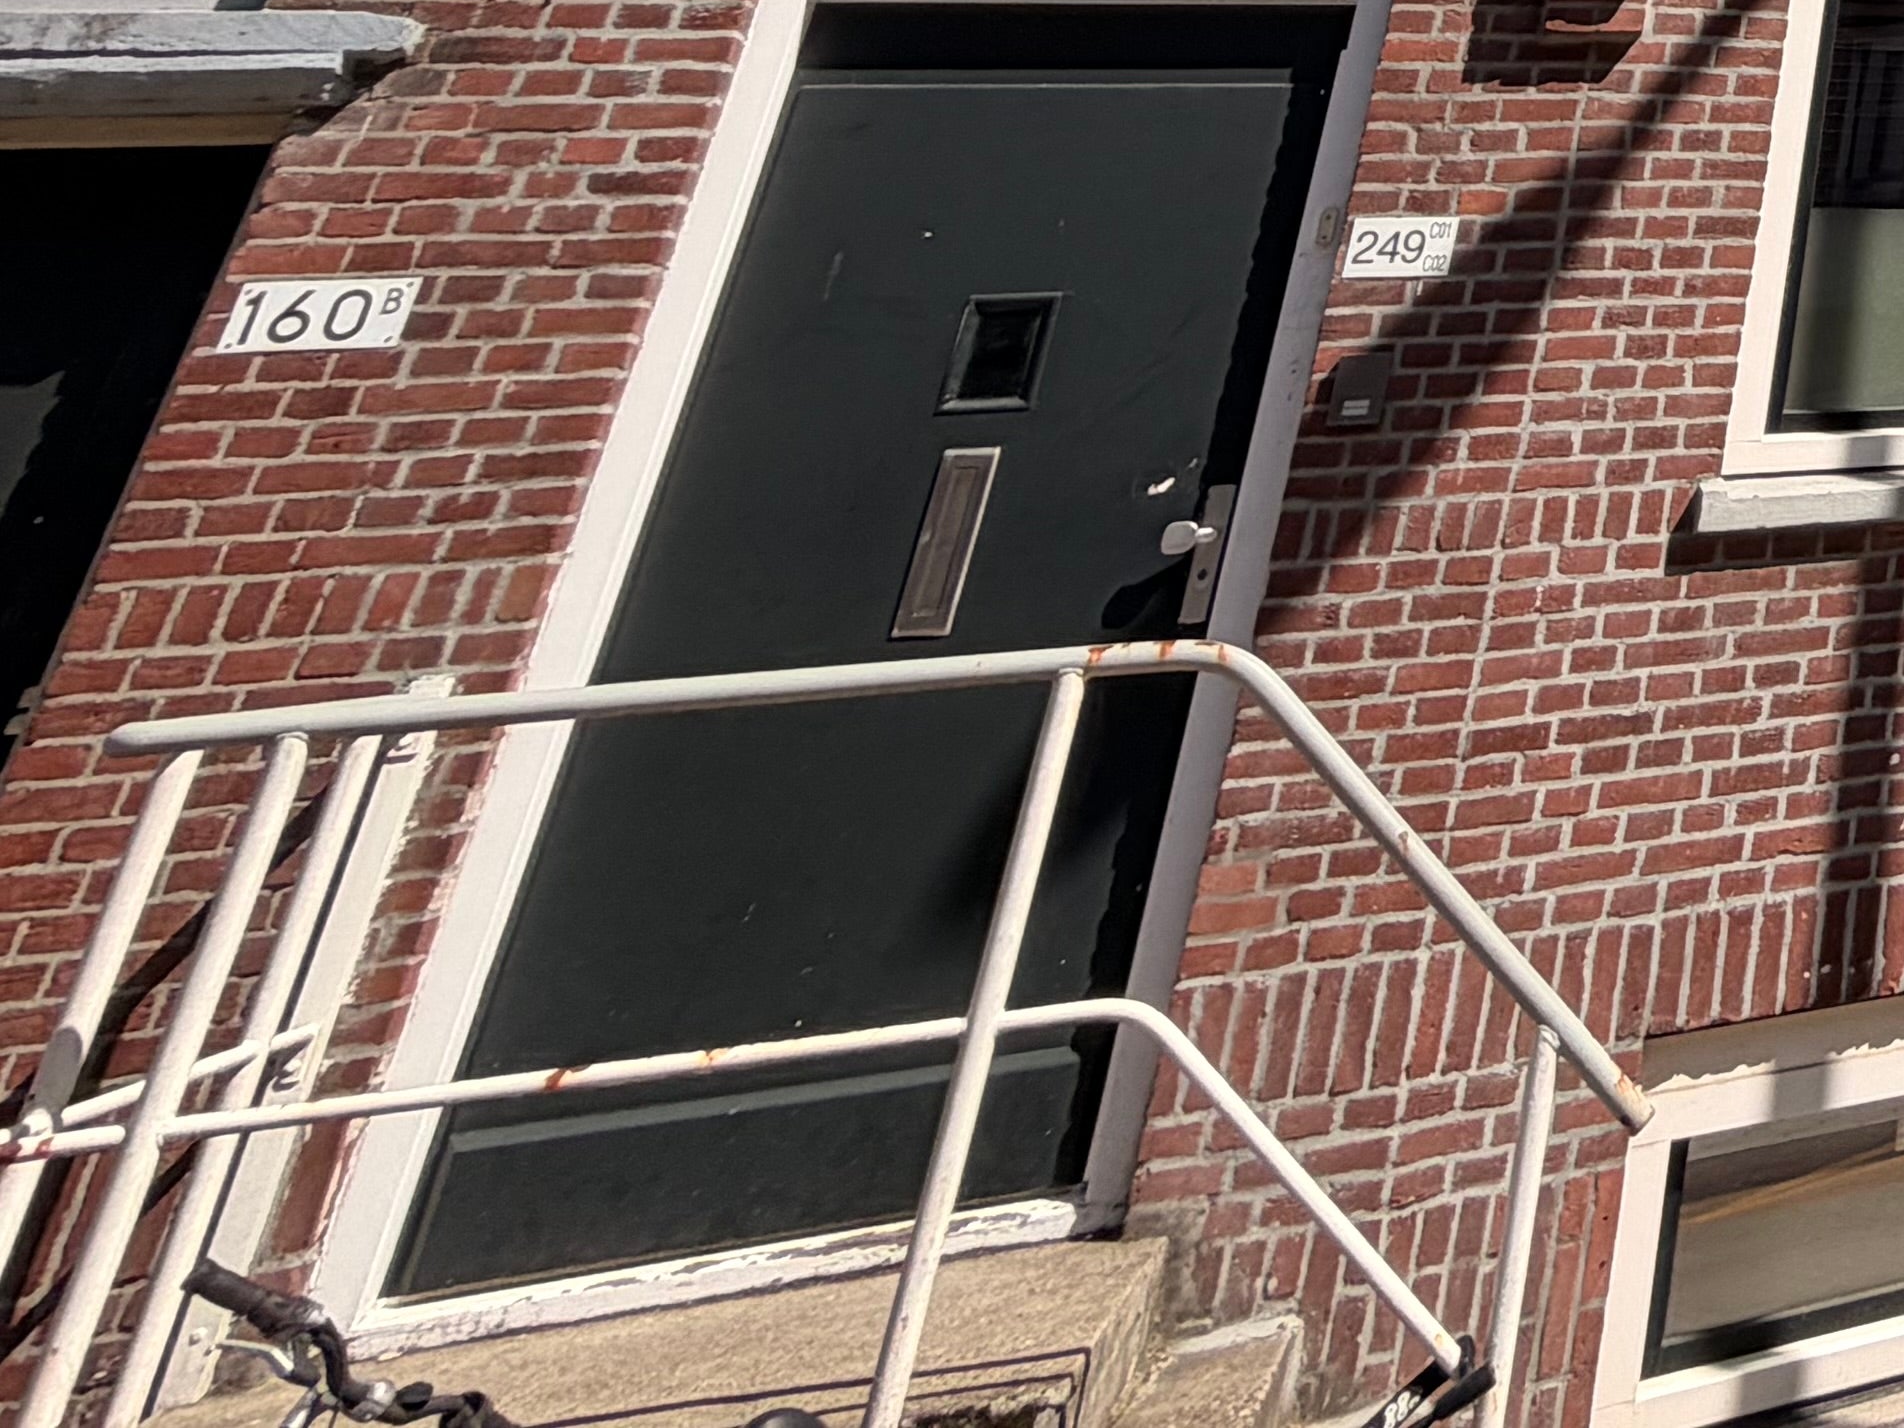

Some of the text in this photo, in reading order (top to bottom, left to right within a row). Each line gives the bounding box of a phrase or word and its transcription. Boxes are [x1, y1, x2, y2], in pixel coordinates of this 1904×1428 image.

[1430, 221, 1453, 239] C01
[1351, 230, 1426, 264] 249
[1422, 255, 1447, 272] C02
[236, 287, 404, 346] 160 B
